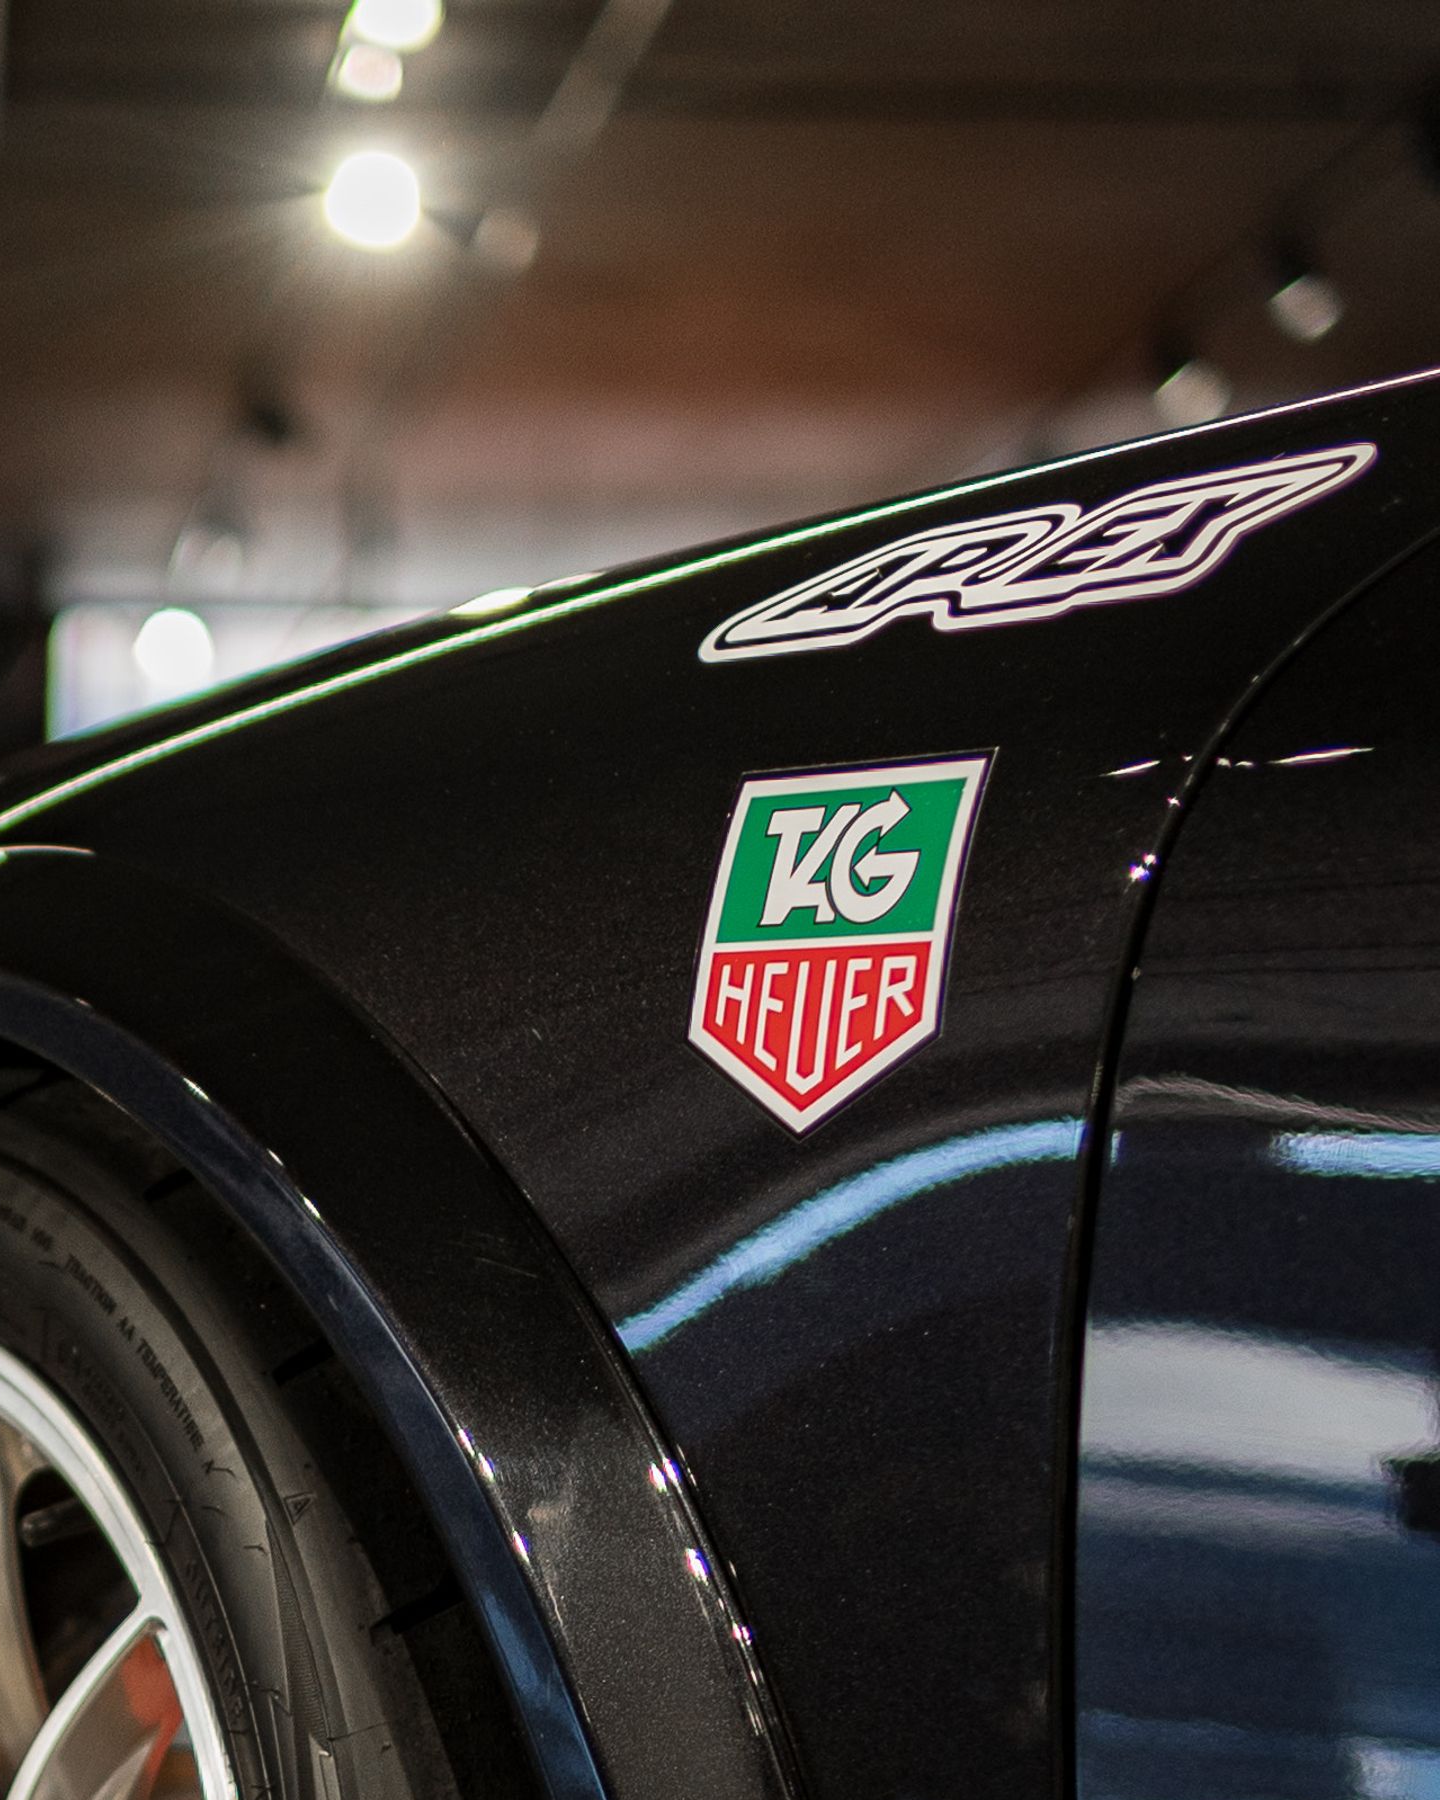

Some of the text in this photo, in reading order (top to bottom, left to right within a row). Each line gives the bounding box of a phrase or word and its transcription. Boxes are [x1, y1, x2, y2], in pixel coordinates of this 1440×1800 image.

[701, 444, 1375, 660] APEX
[758, 788, 921, 928] TAG
[715, 956, 918, 1095] HEUER
